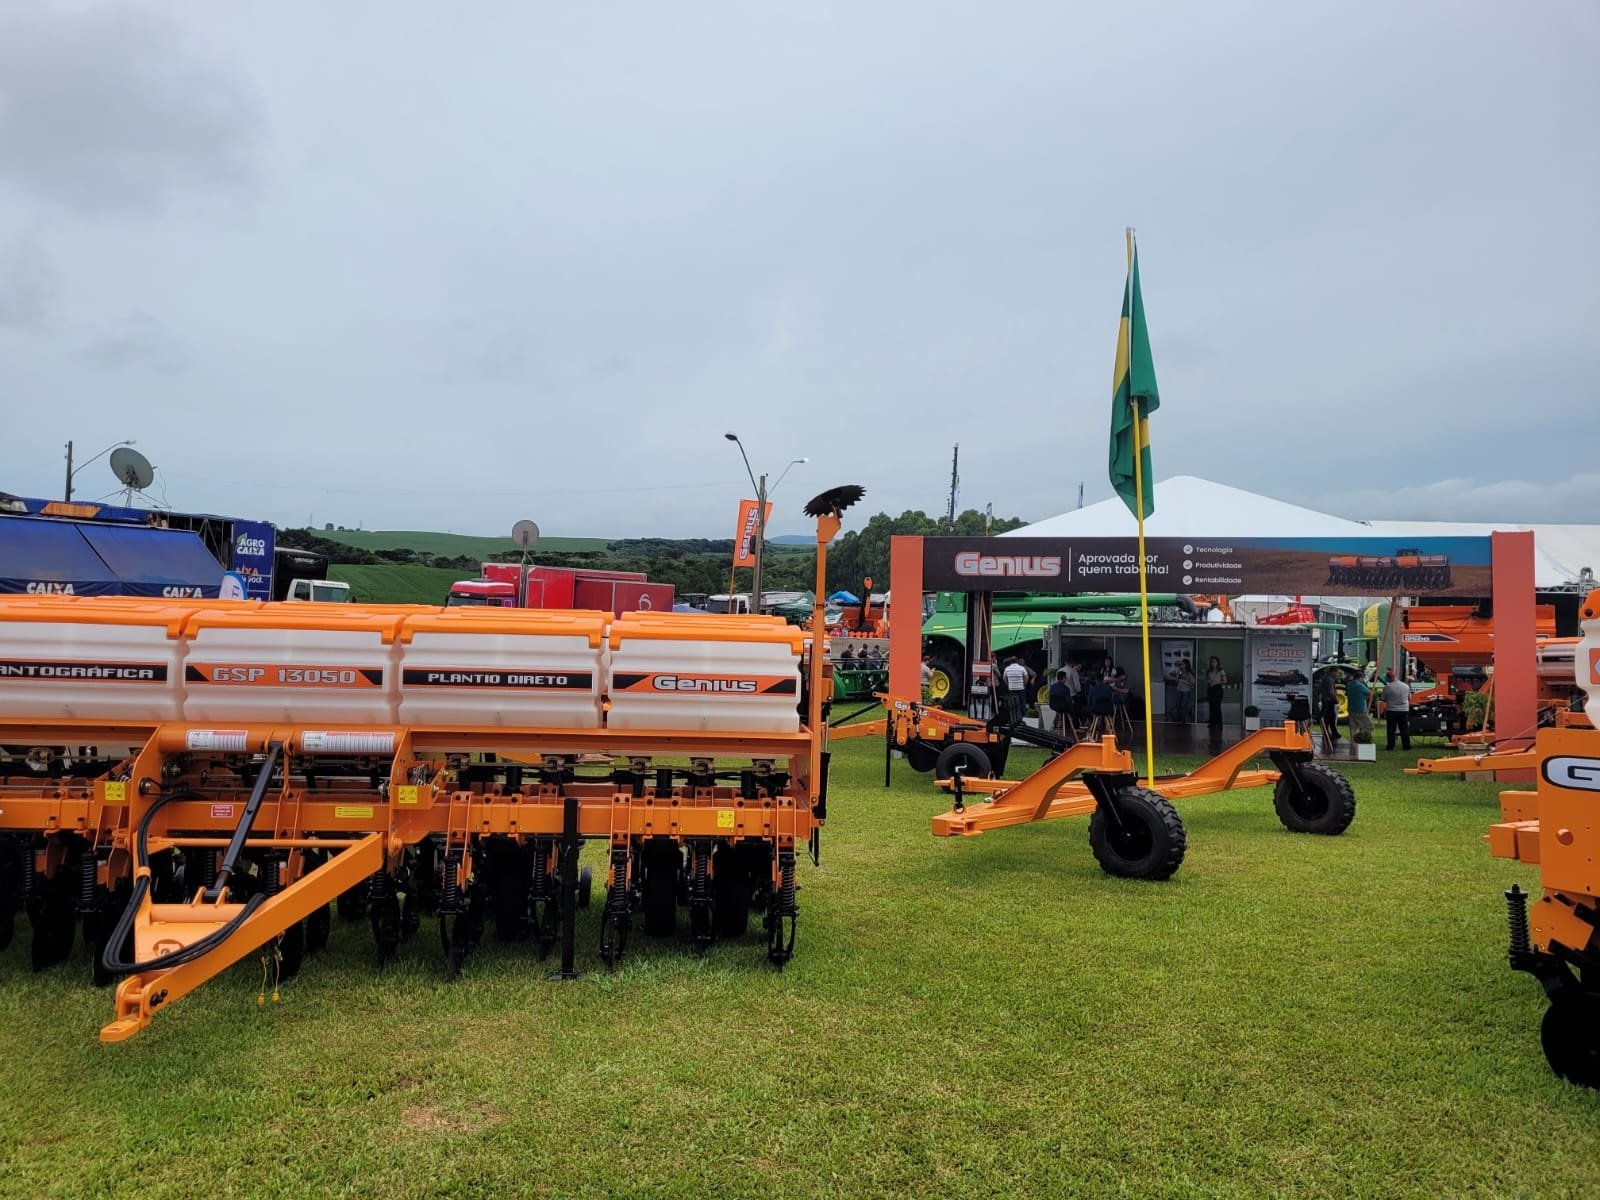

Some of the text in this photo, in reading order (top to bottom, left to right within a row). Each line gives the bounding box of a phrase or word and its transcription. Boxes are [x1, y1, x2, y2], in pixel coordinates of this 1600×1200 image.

[239, 539, 265, 548] AGRO
[236, 547, 265, 556] CAIXA
[1195, 546, 1233, 554] Tecnologia
[954, 551, 1062, 577] Genius
[1078, 553, 1159, 565] Aprovada or
[1078, 564, 1169, 577] quem trablha!
[26, 582, 76, 596] CAIXA
[162, 586, 203, 598] CAIXA
[212, 667, 357, 684] GSP 13050
[428, 673, 568, 685] PLANTIO DIRETO
[652, 674, 758, 693] Genius
